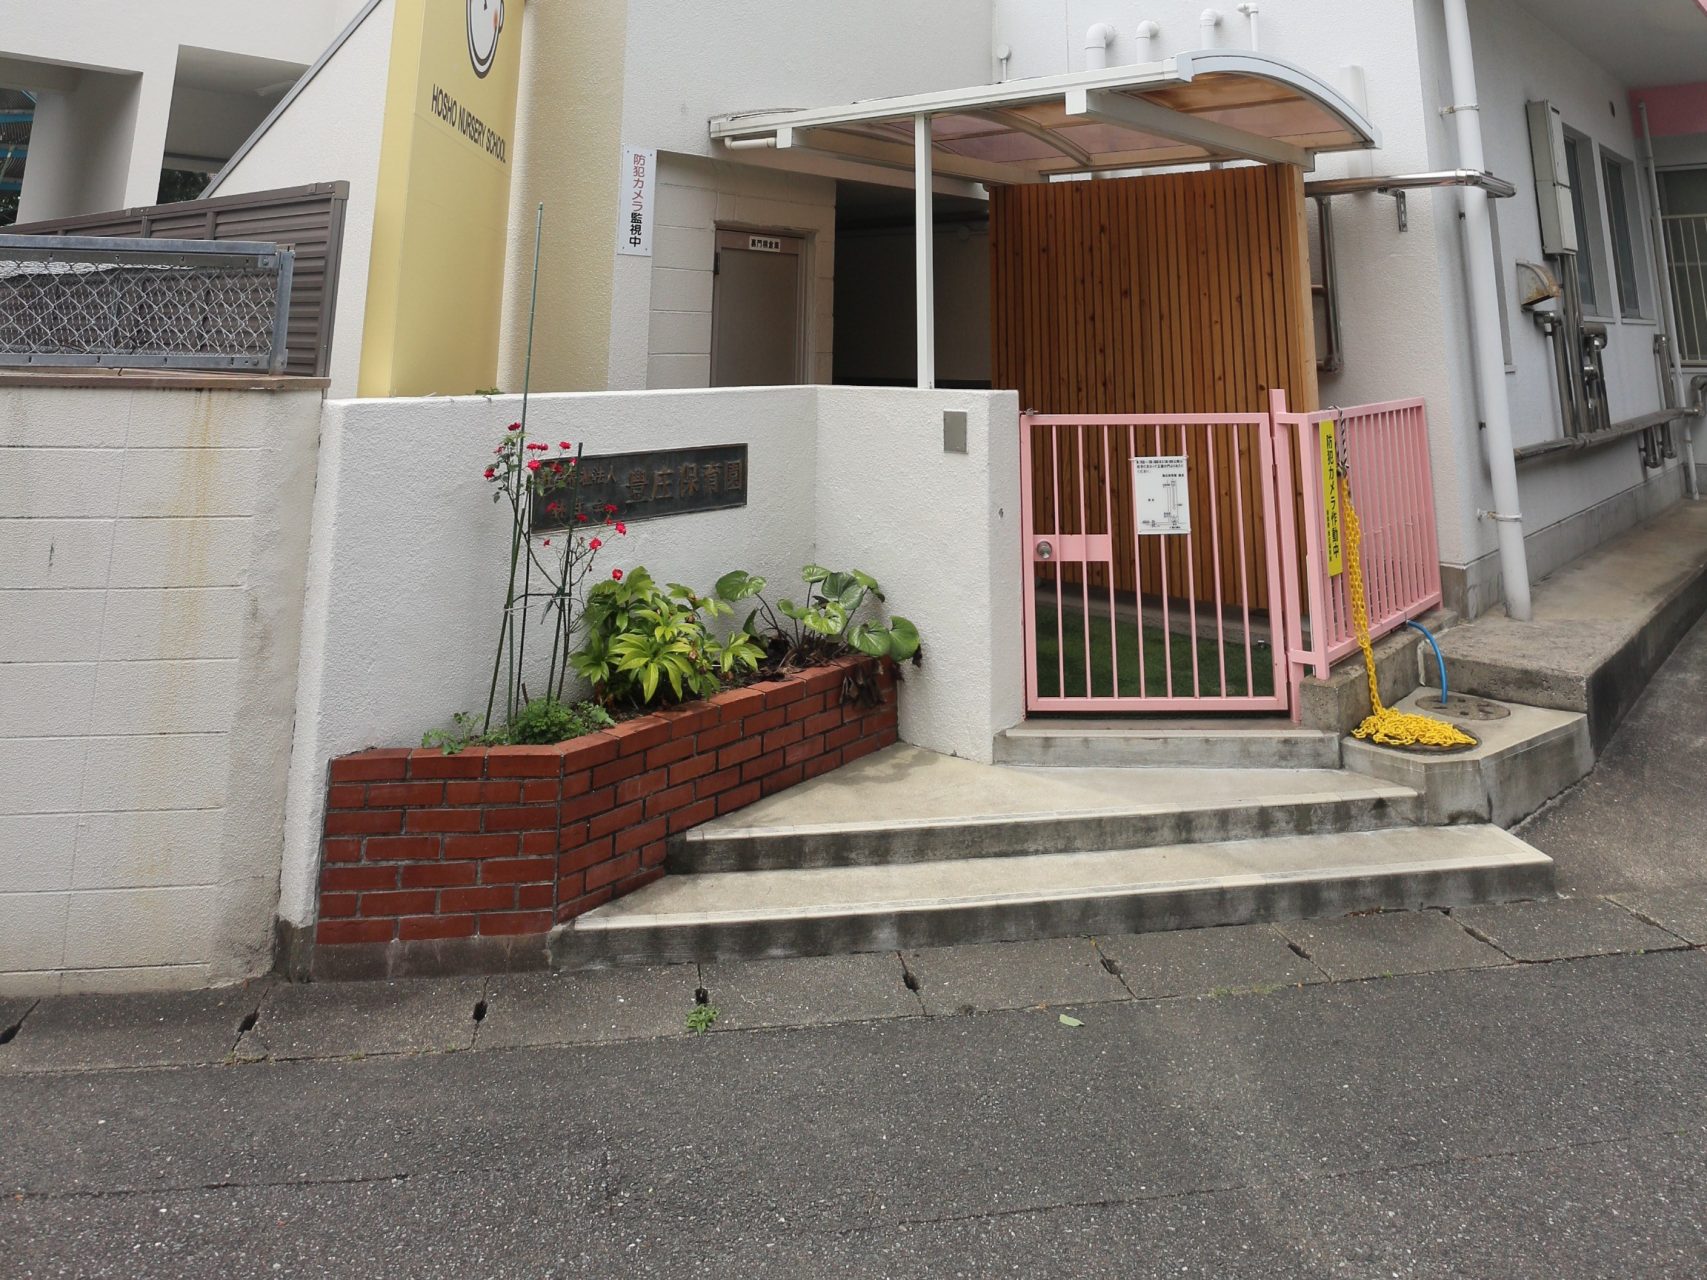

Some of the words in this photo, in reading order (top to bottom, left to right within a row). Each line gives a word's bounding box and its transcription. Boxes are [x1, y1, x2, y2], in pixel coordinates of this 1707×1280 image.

[431, 83, 457, 127] HOSHO
[458, 104, 487, 148] NURSERY
[486, 128, 506, 163] SCHOOL
[629, 153, 646, 248] 防犯カメラ監視中
[1326, 434, 1339, 558] 防犯カメラ作動中
